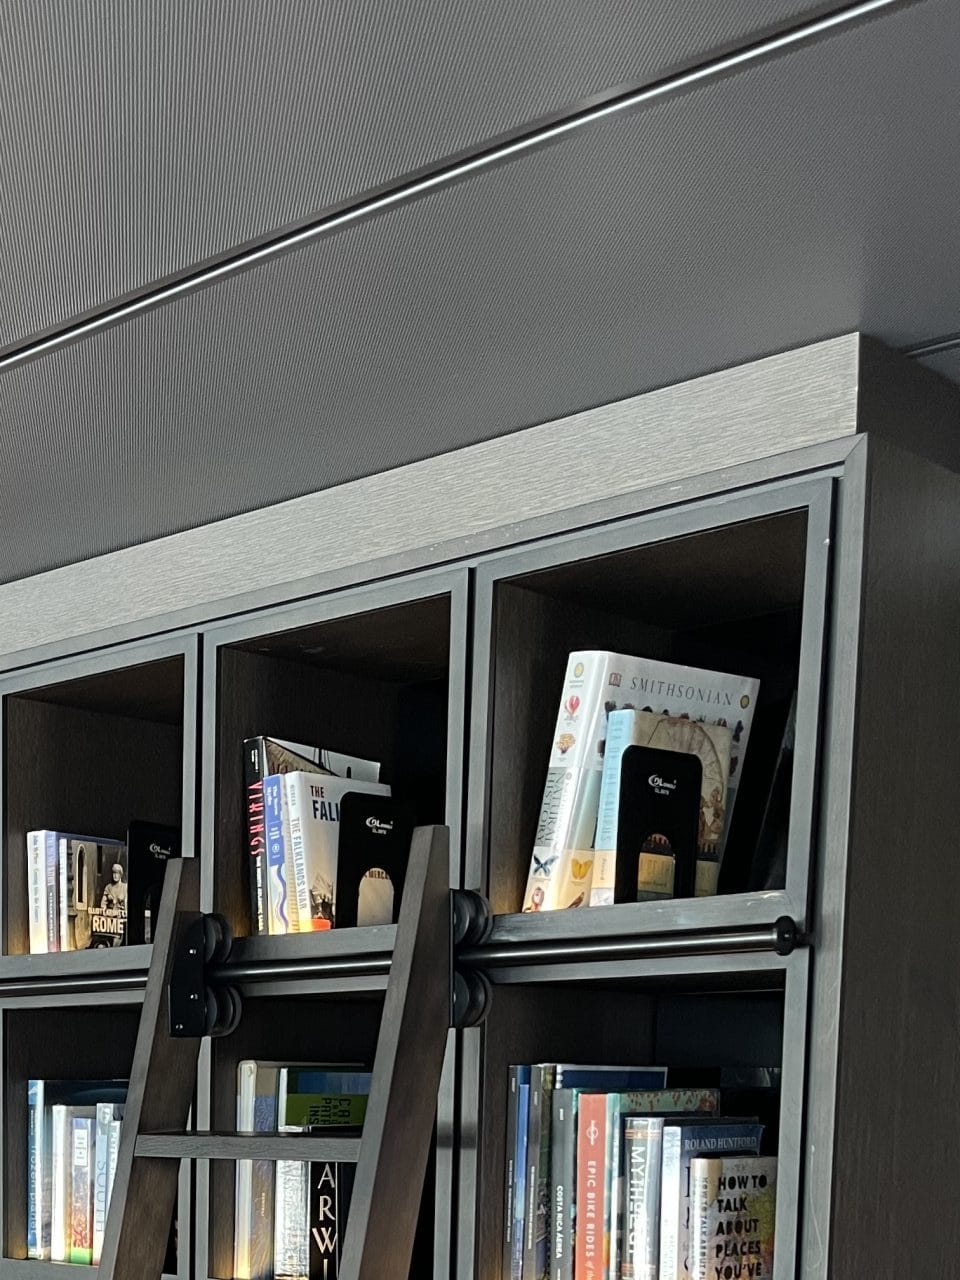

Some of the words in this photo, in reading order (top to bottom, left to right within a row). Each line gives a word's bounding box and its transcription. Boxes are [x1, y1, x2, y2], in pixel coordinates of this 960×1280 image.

[630, 676, 734, 706] SMITHSONIAN
[310, 785, 324, 798] THE
[248, 781, 264, 856] VIKINGS
[292, 818, 300, 833] THE
[293, 836, 305, 887] FALKLANDS
[298, 889, 307, 910] WAR
[92, 915, 124, 933] ROME
[684, 1138, 717, 1150] ROLAND
[587, 1160, 596, 1187] EPIC
[718, 1175, 749, 1191] HOW
[751, 1174, 768, 1189] TO
[555, 1185, 565, 1212] COSTA
[586, 1192, 596, 1218] BIKE
[717, 1196, 747, 1212] TALK
[555, 1213, 564, 1231] RICA
[715, 1219, 759, 1235] ABOUT
[585, 1223, 595, 1257] RIDES
[715, 1241, 761, 1258] PLACES
[715, 1263, 762, 1280] YOU'VE
